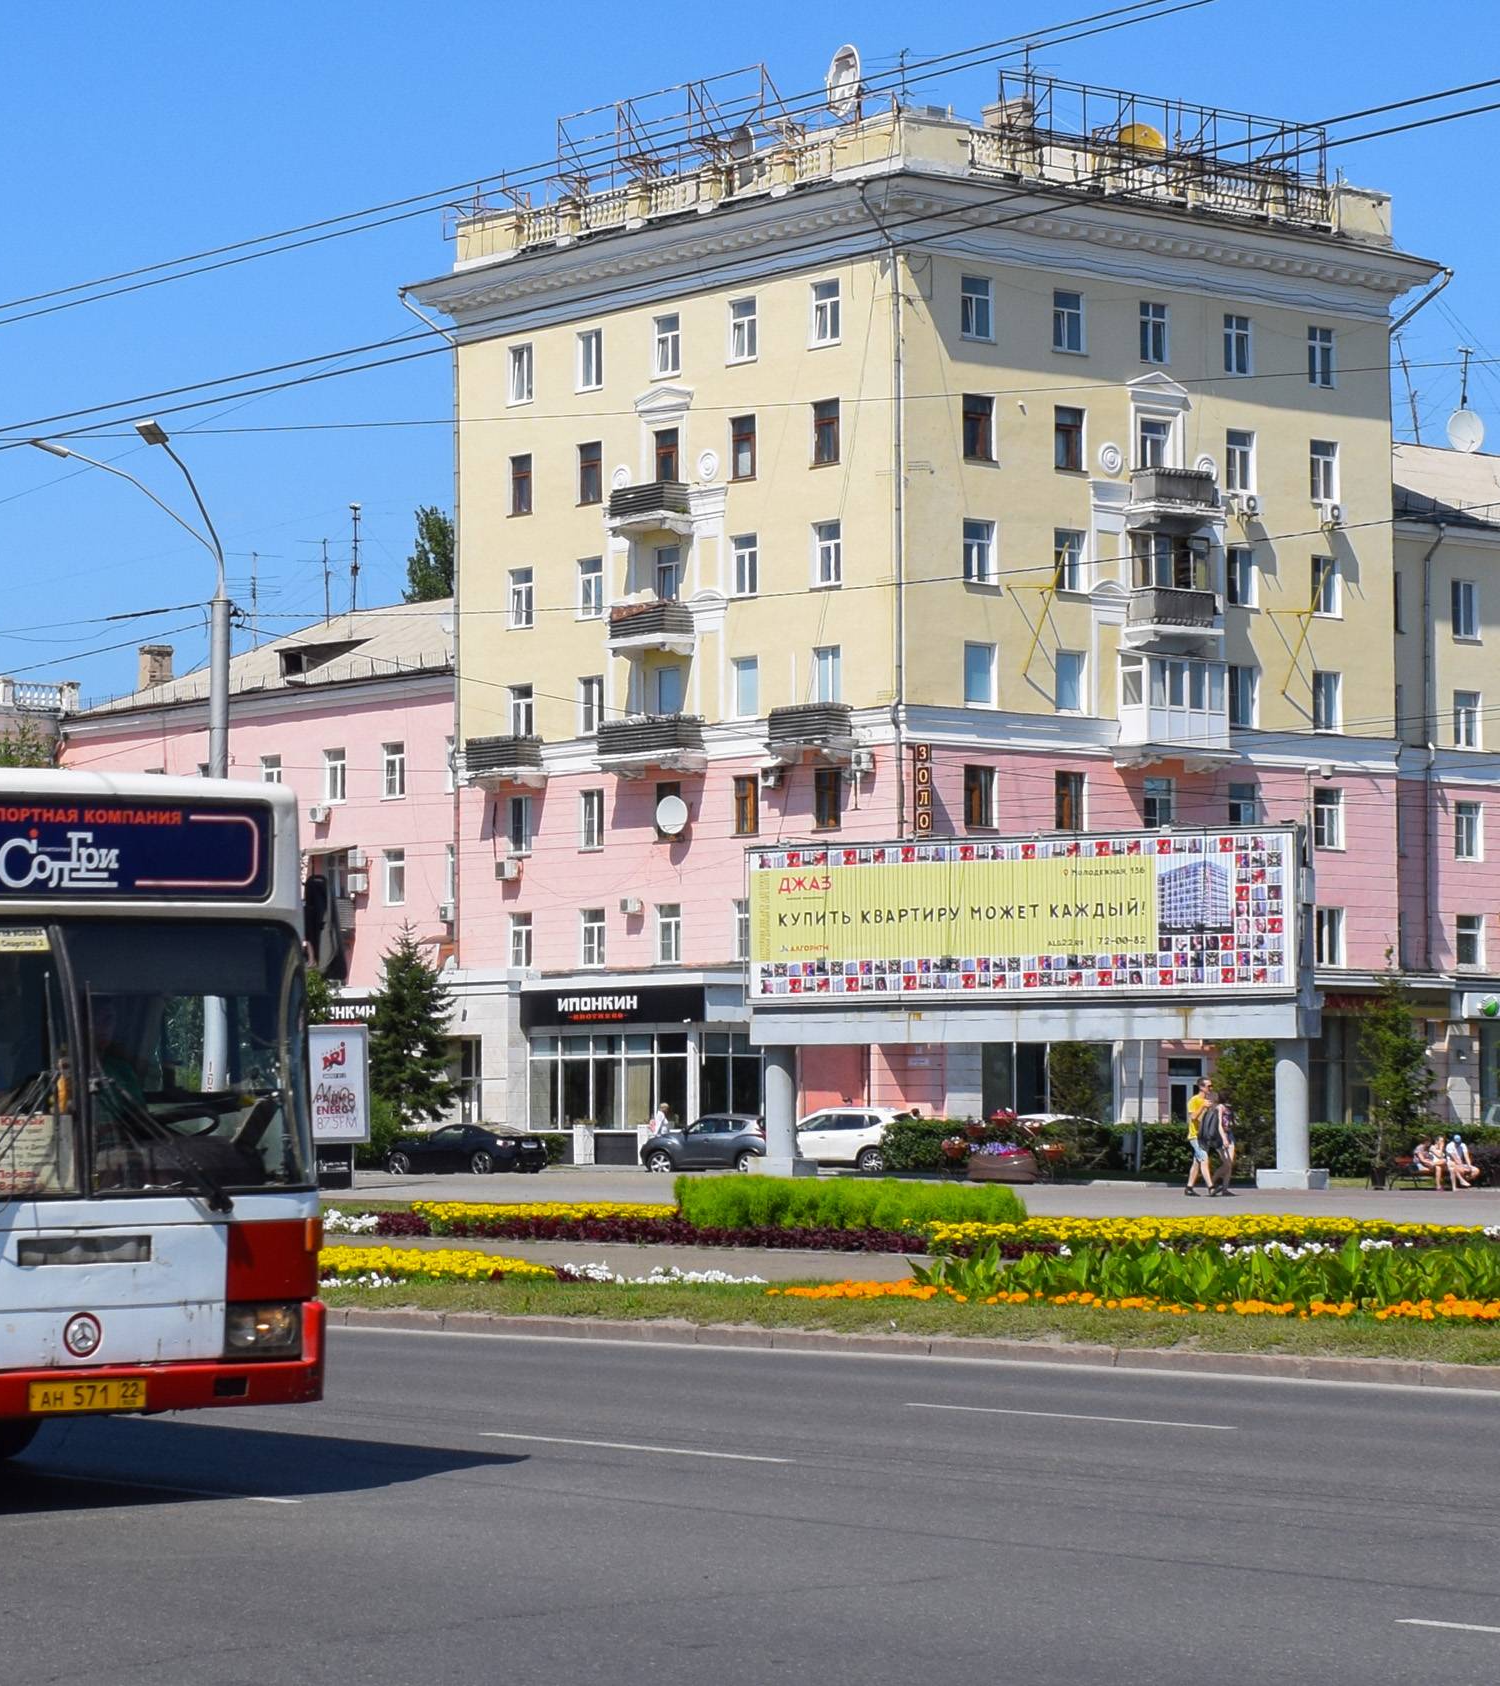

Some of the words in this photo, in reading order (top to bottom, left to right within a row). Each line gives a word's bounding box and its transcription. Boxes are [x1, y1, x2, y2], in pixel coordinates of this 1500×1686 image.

[83, 808, 182, 826] КОМПАНИЯ
[778, 875, 832, 894] ДЖАЗ
[778, 911, 851, 927] КУПИТЬ
[861, 907, 960, 925] КВАРТИРУ
[970, 903, 1040, 921] МОЖЕТ
[1050, 898, 1146, 919] КАЖДЫЙ!
[557, 995, 638, 1012] ИПОНКИН
[316, 1106, 356, 1115] ENERGY
[41, 1391, 64, 1407] АН
[73, 1385, 109, 1406] 571
[121, 1382, 140, 1399] 22
